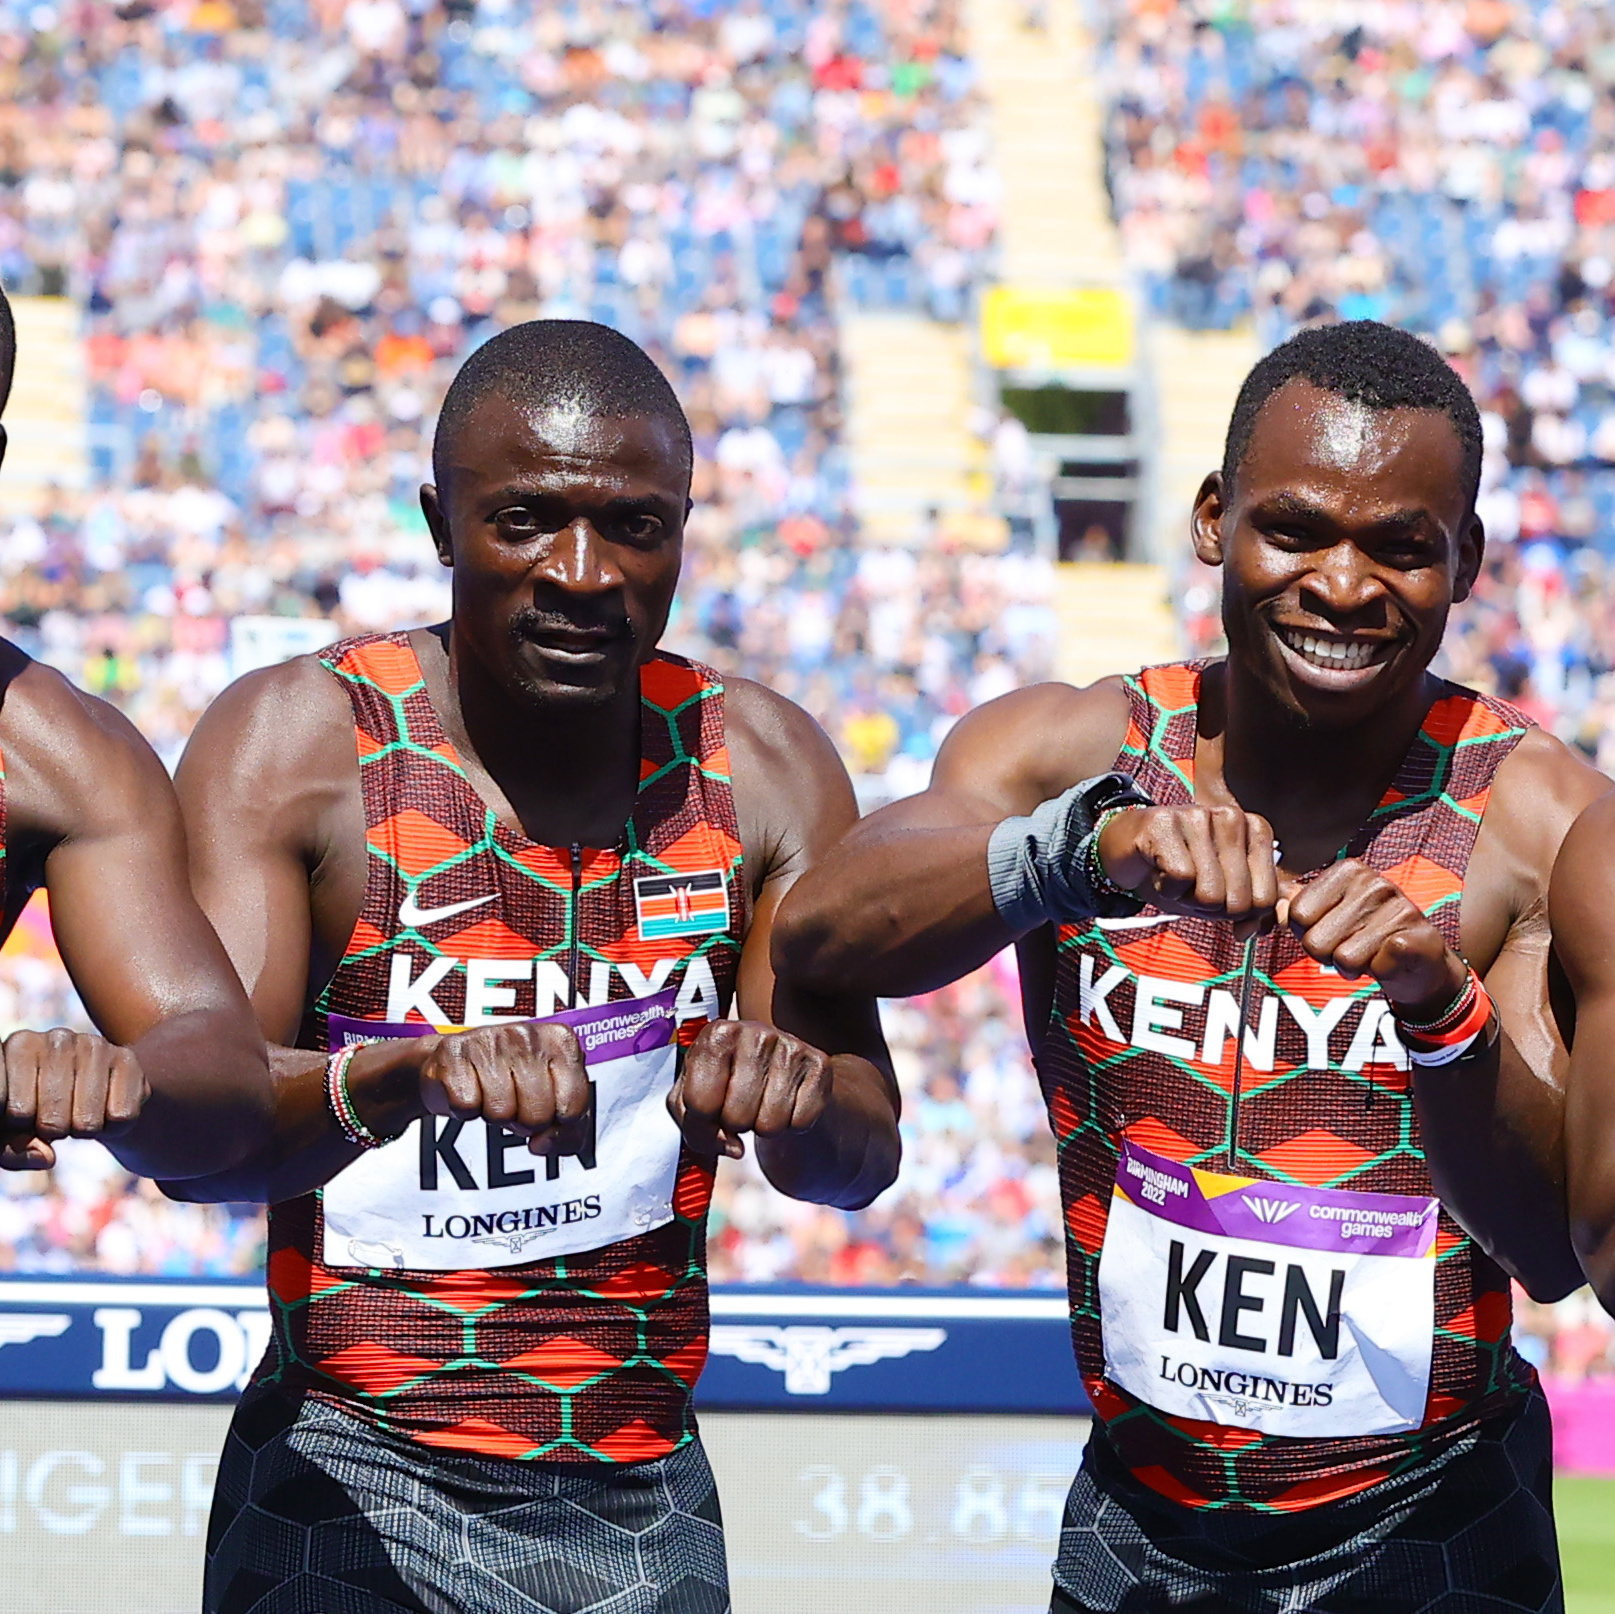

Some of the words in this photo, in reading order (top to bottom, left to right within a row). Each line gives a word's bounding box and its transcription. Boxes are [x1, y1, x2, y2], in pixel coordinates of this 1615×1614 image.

[386, 954, 719, 1028] KENYA
[1079, 954, 1412, 1072] KENYA
[586, 1027, 634, 1050] games
[1126, 1155, 1190, 1199] BIRMINGHAM
[1141, 1181, 1166, 1207] 2022
[422, 1194, 602, 1241] LONGINES
[1309, 1203, 1425, 1228] commonwealth
[1340, 1220, 1394, 1240] games
[1162, 1239, 1346, 1361] KEN
[1159, 1355, 1335, 1407] LONGINES
